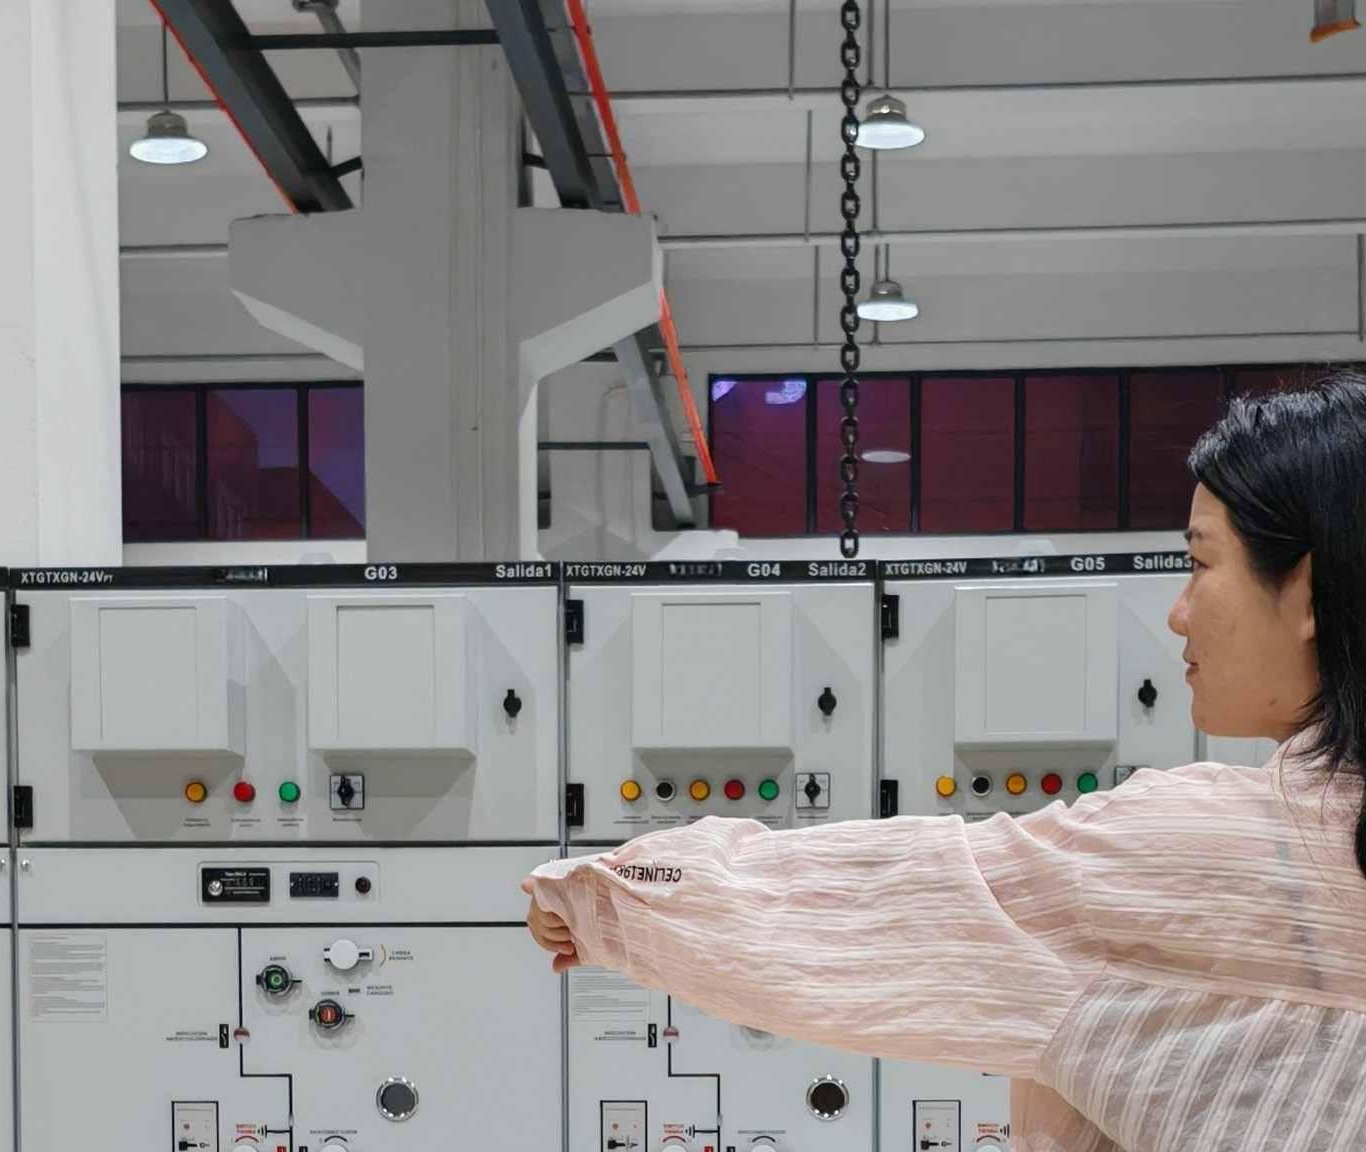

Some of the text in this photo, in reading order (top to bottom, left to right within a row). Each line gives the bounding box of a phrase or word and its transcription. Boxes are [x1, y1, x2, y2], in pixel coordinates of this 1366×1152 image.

[747, 563, 781, 577] G04
[808, 562, 867, 576] Salida2
[1070, 556, 1106, 571] G05
[364, 566, 398, 580] G03
[495, 564, 553, 578] Salida1
